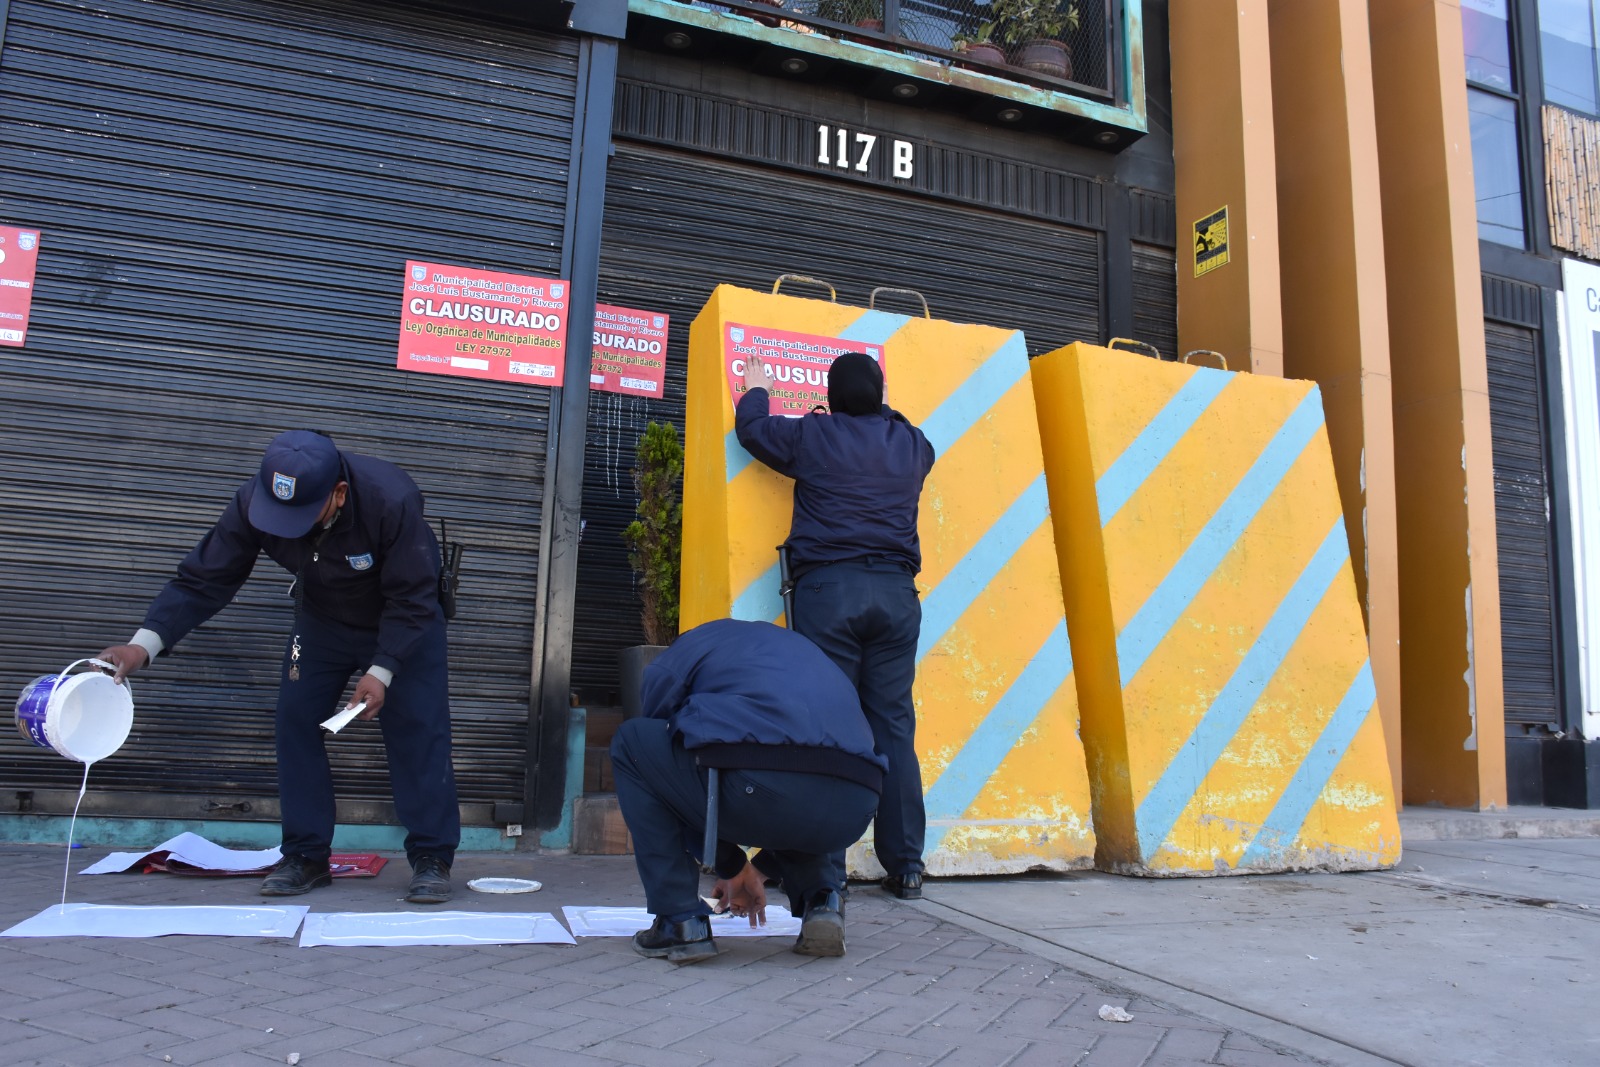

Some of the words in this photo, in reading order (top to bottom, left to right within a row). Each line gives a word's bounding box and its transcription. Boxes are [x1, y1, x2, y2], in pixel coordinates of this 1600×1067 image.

[817, 124, 877, 172] 117
[892, 139, 913, 179] B
[433, 274, 503, 291] Municipalidad
[505, 283, 544, 296] Distrital
[409, 282, 435, 293] José
[437, 285, 459, 296] Luis
[462, 288, 521, 304] Bustamante
[523, 297, 530, 307] y
[532, 297, 564, 309] Rivero
[409, 297, 561, 332] CLAUSURADO
[618, 315, 648, 326] Distrital
[405, 319, 423, 335] Ley
[425, 322, 469, 338] Orgánica
[471, 327, 484, 339] de
[486, 329, 562, 349] Municipalidades
[632, 327, 638, 335] y
[638, 326, 664, 337] Rivero
[455, 342, 477, 353] LEY
[480, 345, 512, 358] 27972
[753, 336, 819, 353] Municipalidad
[603, 353, 661, 368] Municipalidades
[733, 344, 756, 354] José
[758, 347, 780, 358] Luis
[782, 351, 836, 365] Bustamant
[598, 365, 622, 373] 27972
[797, 388, 809, 400] de
[783, 401, 805, 410] LEY
